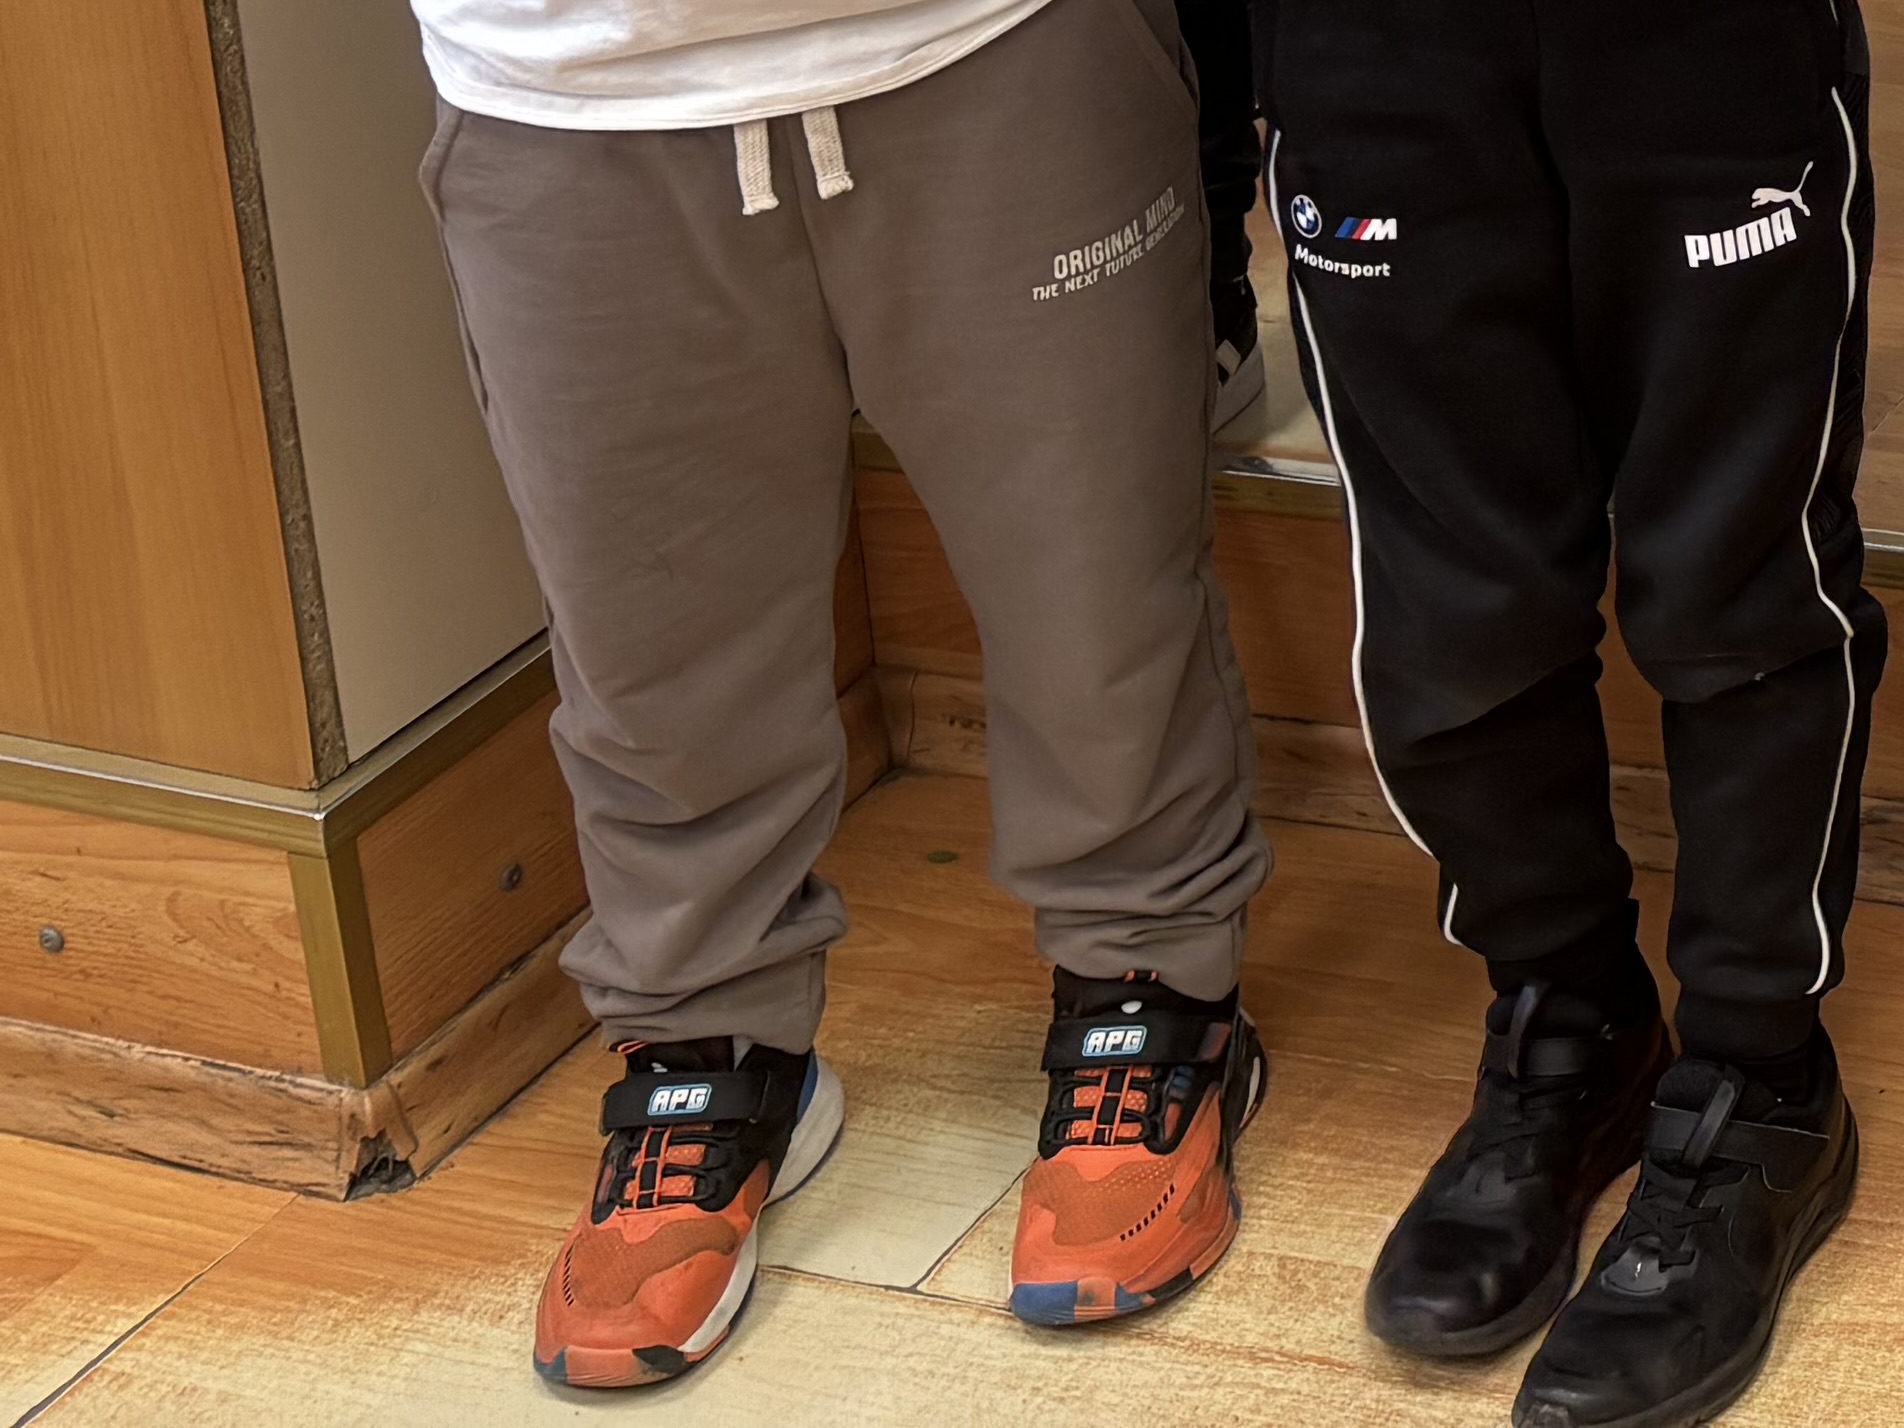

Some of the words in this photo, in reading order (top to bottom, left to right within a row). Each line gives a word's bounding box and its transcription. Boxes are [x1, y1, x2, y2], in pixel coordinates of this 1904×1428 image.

[1053, 219, 1143, 280] ORIGINAL
[1684, 207, 1797, 267] PUMA
[1295, 244, 1390, 279] Motorsport
[1032, 283, 1059, 301] THE
[1065, 268, 1100, 294] NEXT
[1088, 1029, 1144, 1054] APG
[653, 1088, 706, 1112] APG
